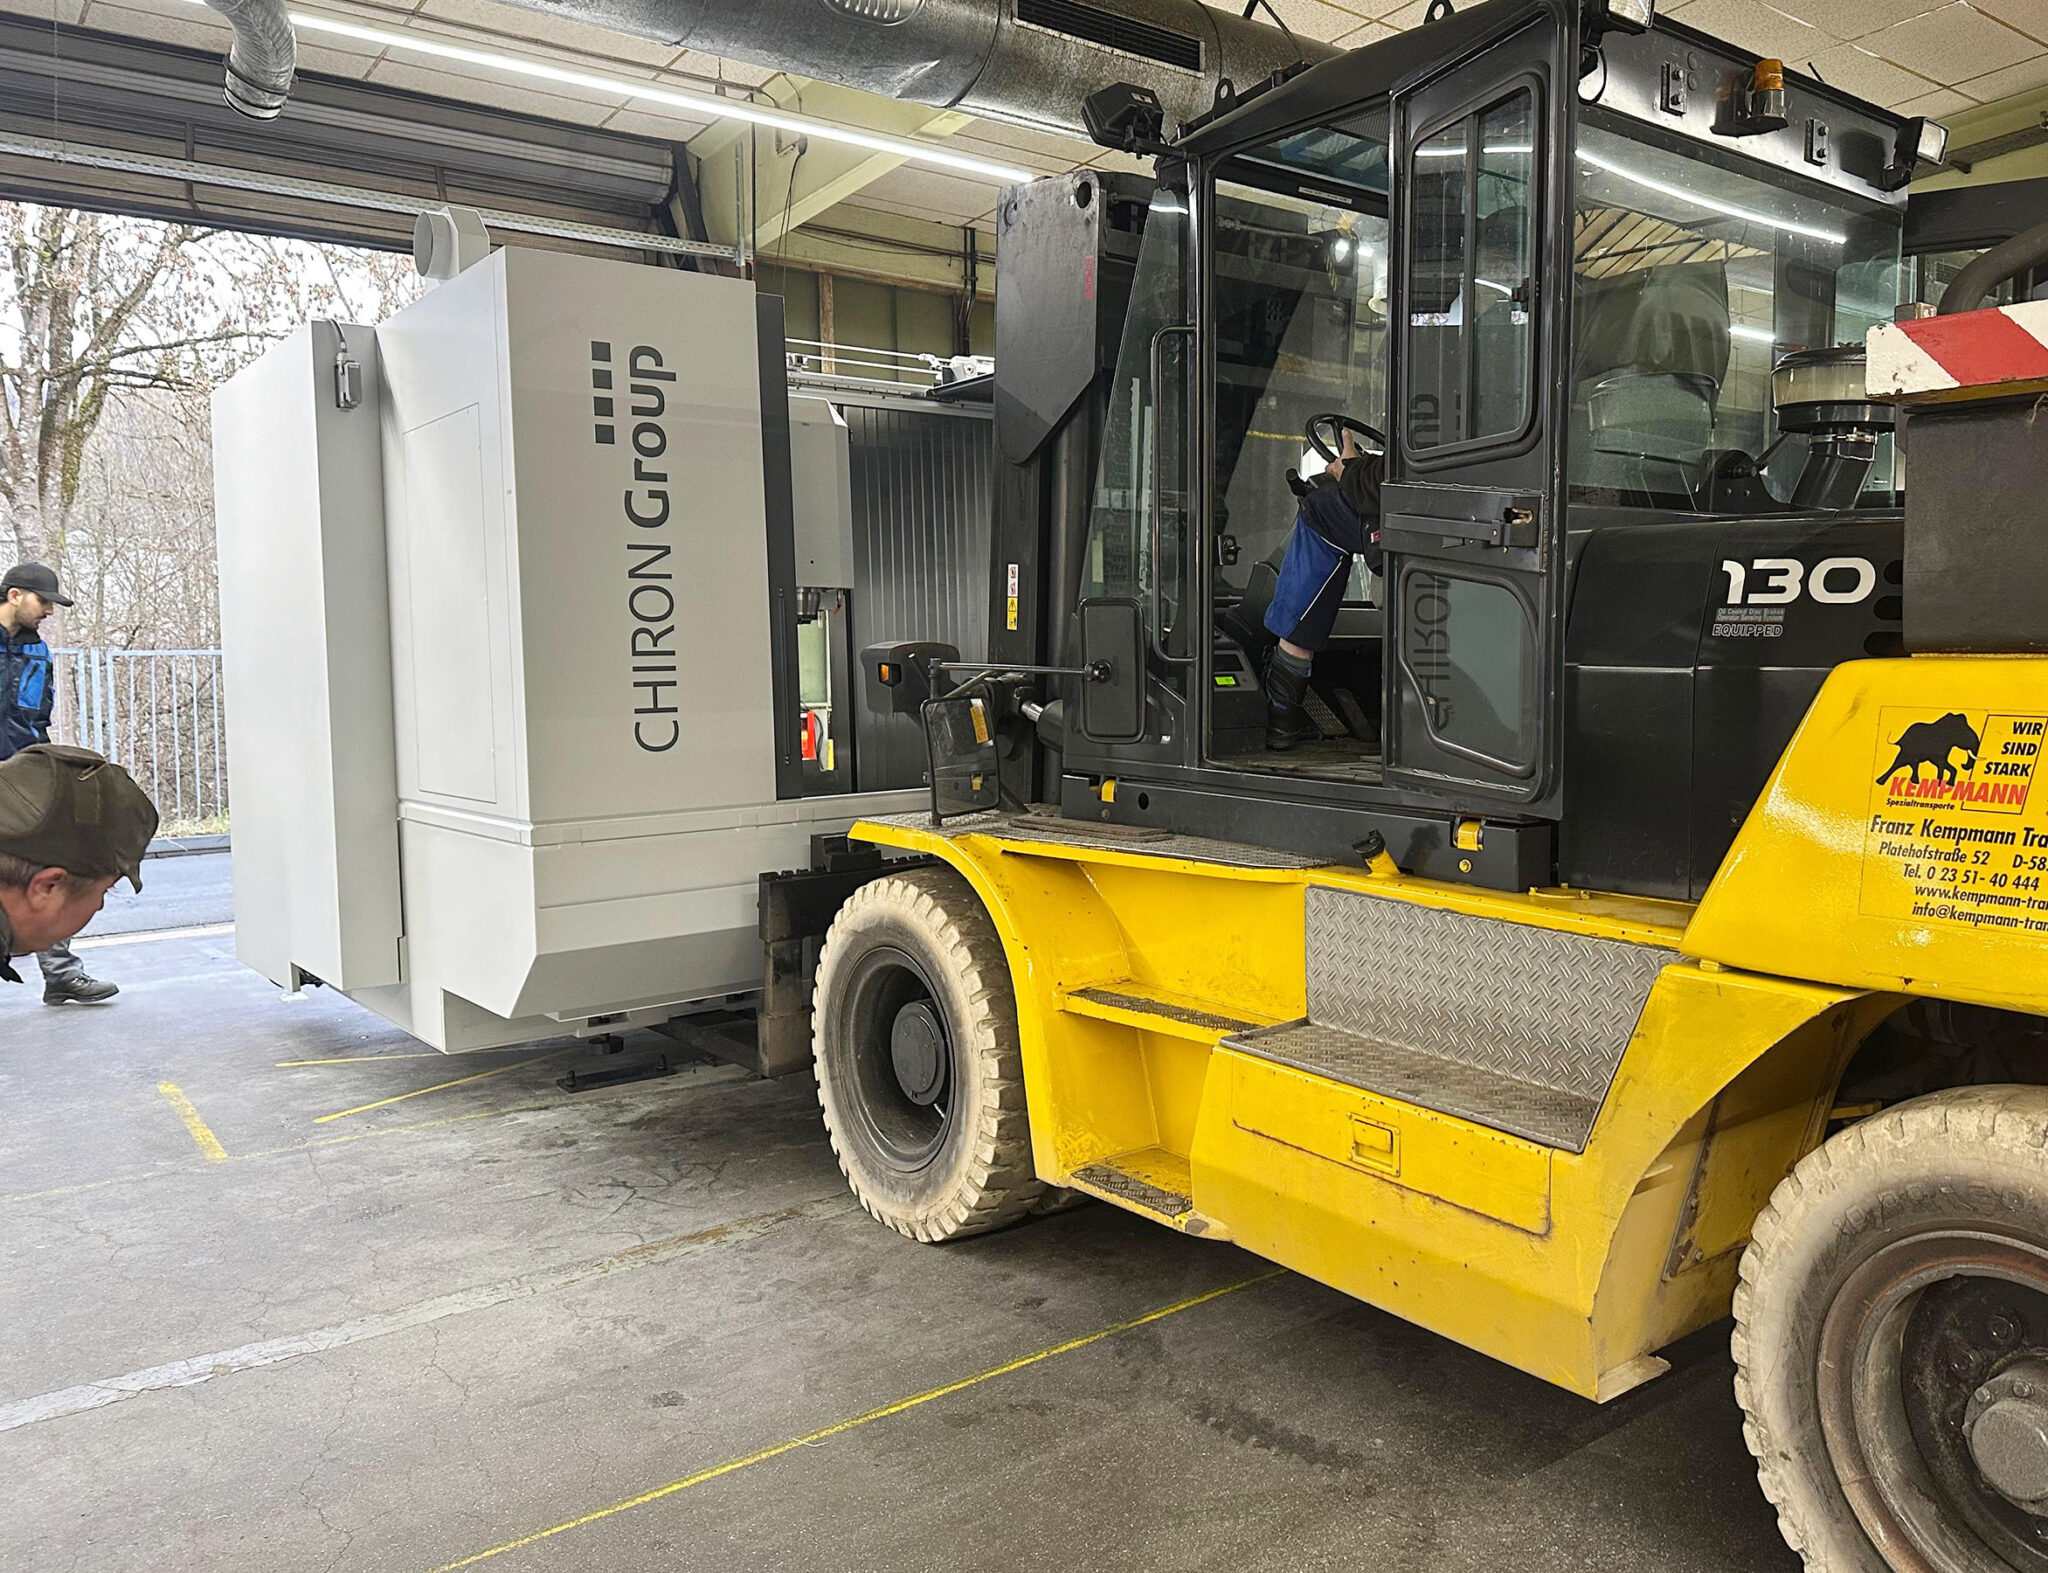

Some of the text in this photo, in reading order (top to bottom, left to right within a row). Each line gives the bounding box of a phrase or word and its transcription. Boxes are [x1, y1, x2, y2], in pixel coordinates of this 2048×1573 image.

[624, 345, 680, 753] CHIRON Group
[1721, 557, 1876, 605] 130
[1712, 623, 1784, 638] EQUIPPED
[2013, 721, 2043, 736] WIR
[2001, 741, 2038, 756] SIND
[1984, 761, 2032, 777] STARK
[1886, 797, 1956, 811] Spezialtransporte
[1889, 776, 2027, 806] KEMPMANN
[1870, 814, 1915, 836] Franz
[1919, 818, 2017, 847] Kempmann
[1878, 841, 2048, 871] Platehofstraße 52 D-58
[1903, 863, 1922, 879] Tel.
[1927, 866, 1936, 880] 0
[1939, 867, 1958, 882] 23
[1989, 872, 2008, 888] 40
[2012, 875, 2040, 892] 444
